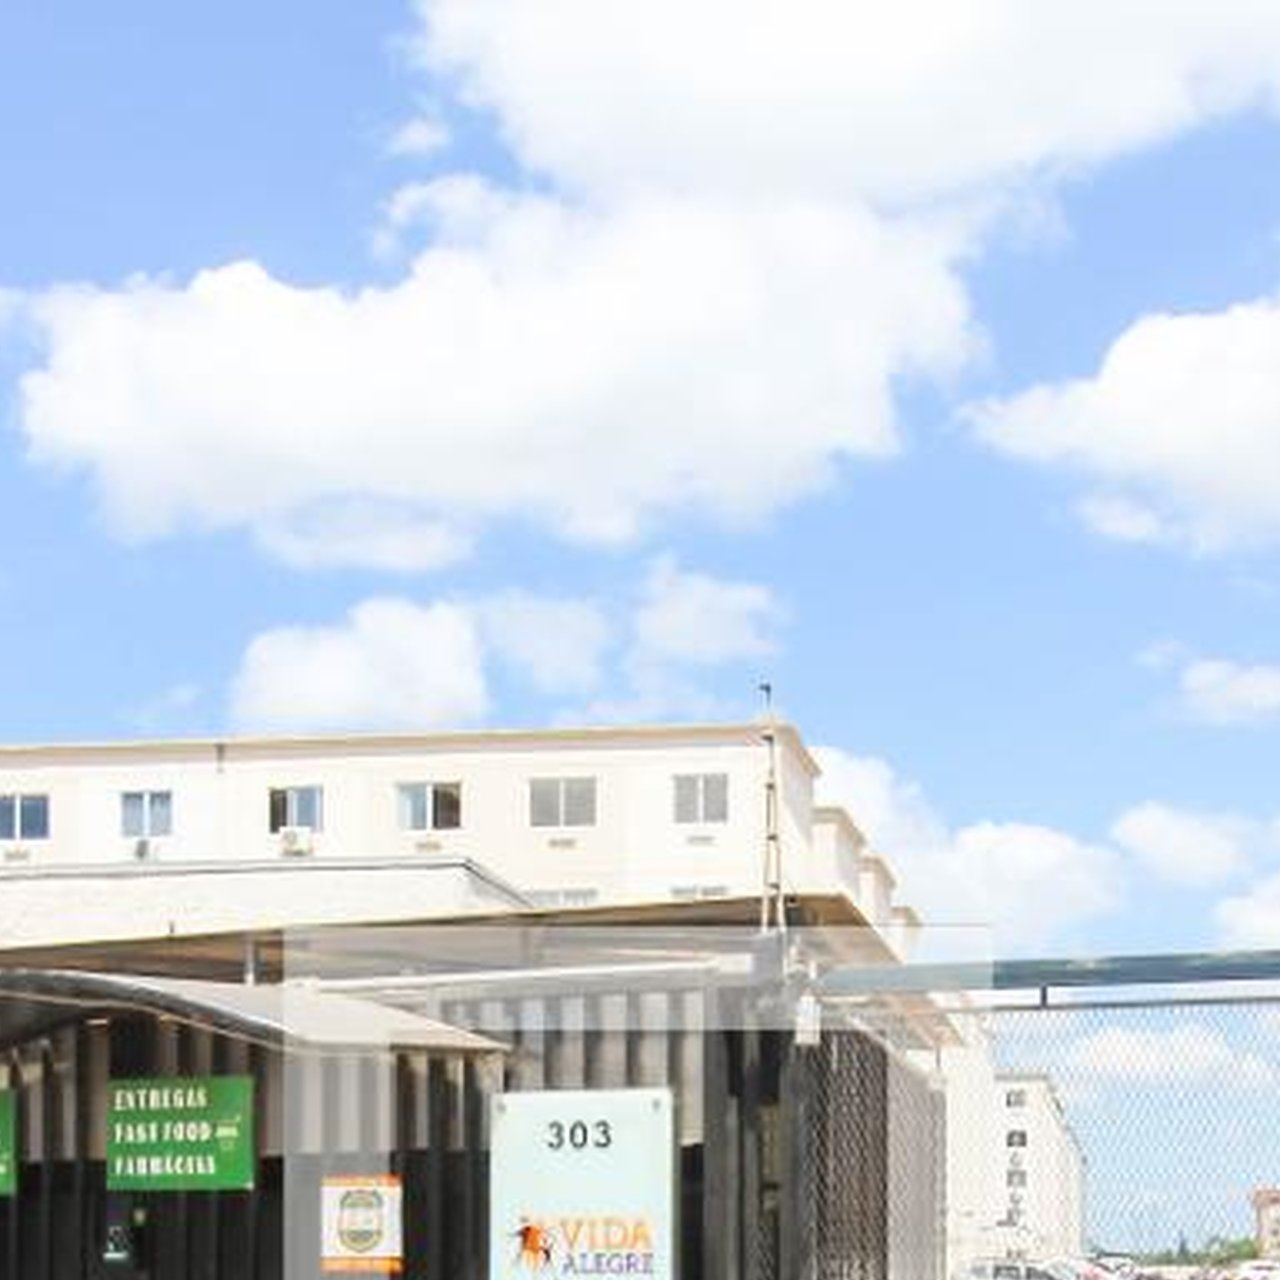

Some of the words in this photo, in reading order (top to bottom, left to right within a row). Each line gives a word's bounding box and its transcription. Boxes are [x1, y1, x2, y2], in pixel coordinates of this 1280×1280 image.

[114, 1087, 208, 1111] ENTREGAS
[115, 1121, 159, 1143] FAST
[163, 1120, 212, 1142] FOOD
[548, 1120, 612, 1150] 303
[559, 1217, 654, 1250] VIDA
[562, 1252, 654, 1275] ALEGRE
